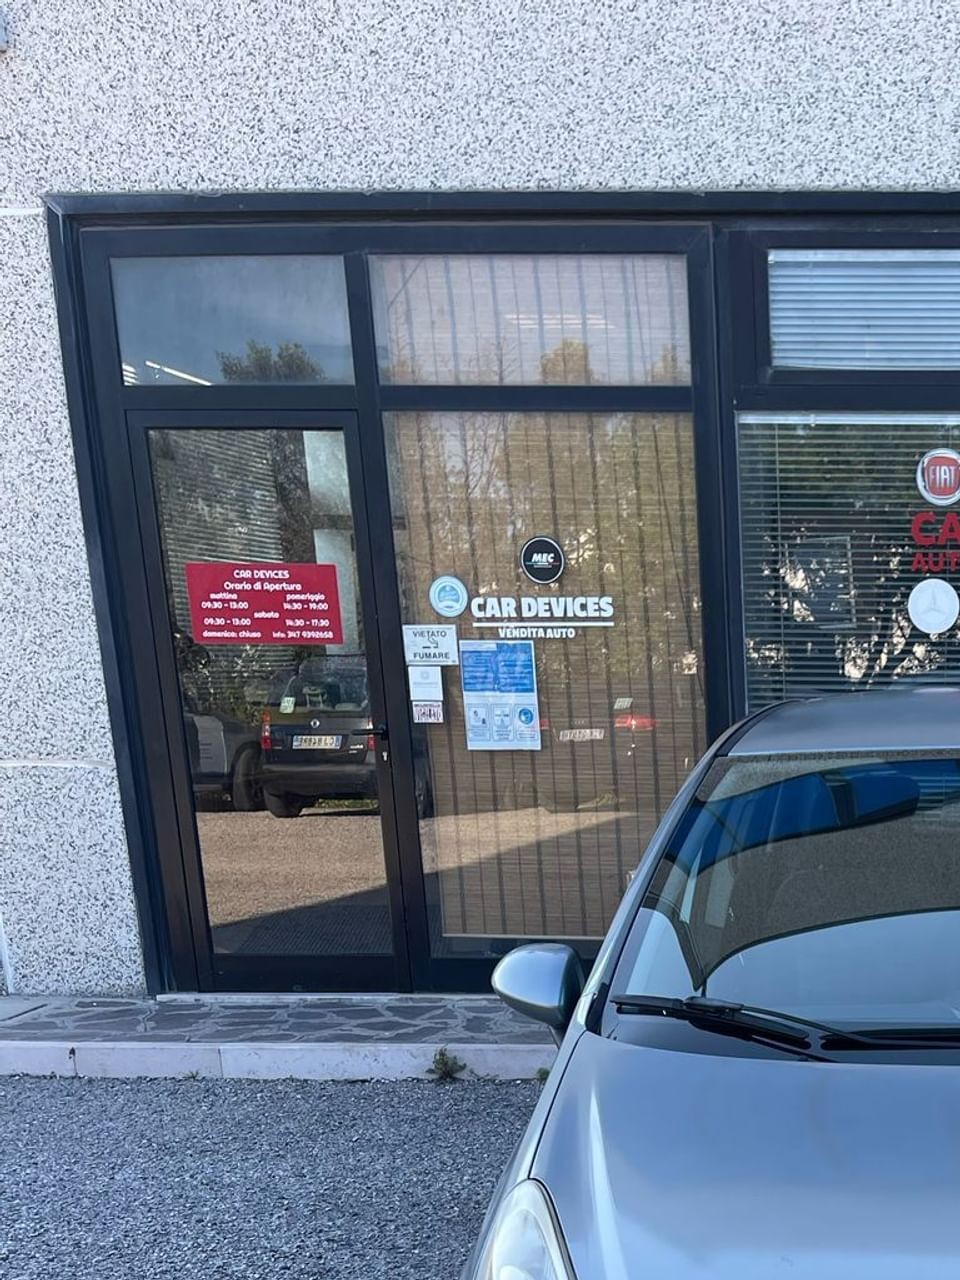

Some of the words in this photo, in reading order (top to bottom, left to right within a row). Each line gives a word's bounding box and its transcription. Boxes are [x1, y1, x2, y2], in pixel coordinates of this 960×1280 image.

[929, 465, 956, 488] FIAT
[532, 553, 555, 563] MEC
[233, 570, 252, 579] CAR
[253, 570, 290, 579] DEVICES
[223, 581, 252, 590] Orario
[253, 581, 262, 590] di
[263, 582, 302, 592] Apertura
[471, 597, 517, 618] CAR
[521, 597, 614, 618] DEVICES
[253, 611, 280, 619] sabato
[412, 630, 447, 638] VIETATO
[498, 628, 545, 638] VENDITA
[546, 628, 576, 638] AUTO
[413, 652, 450, 660] FUMARE
